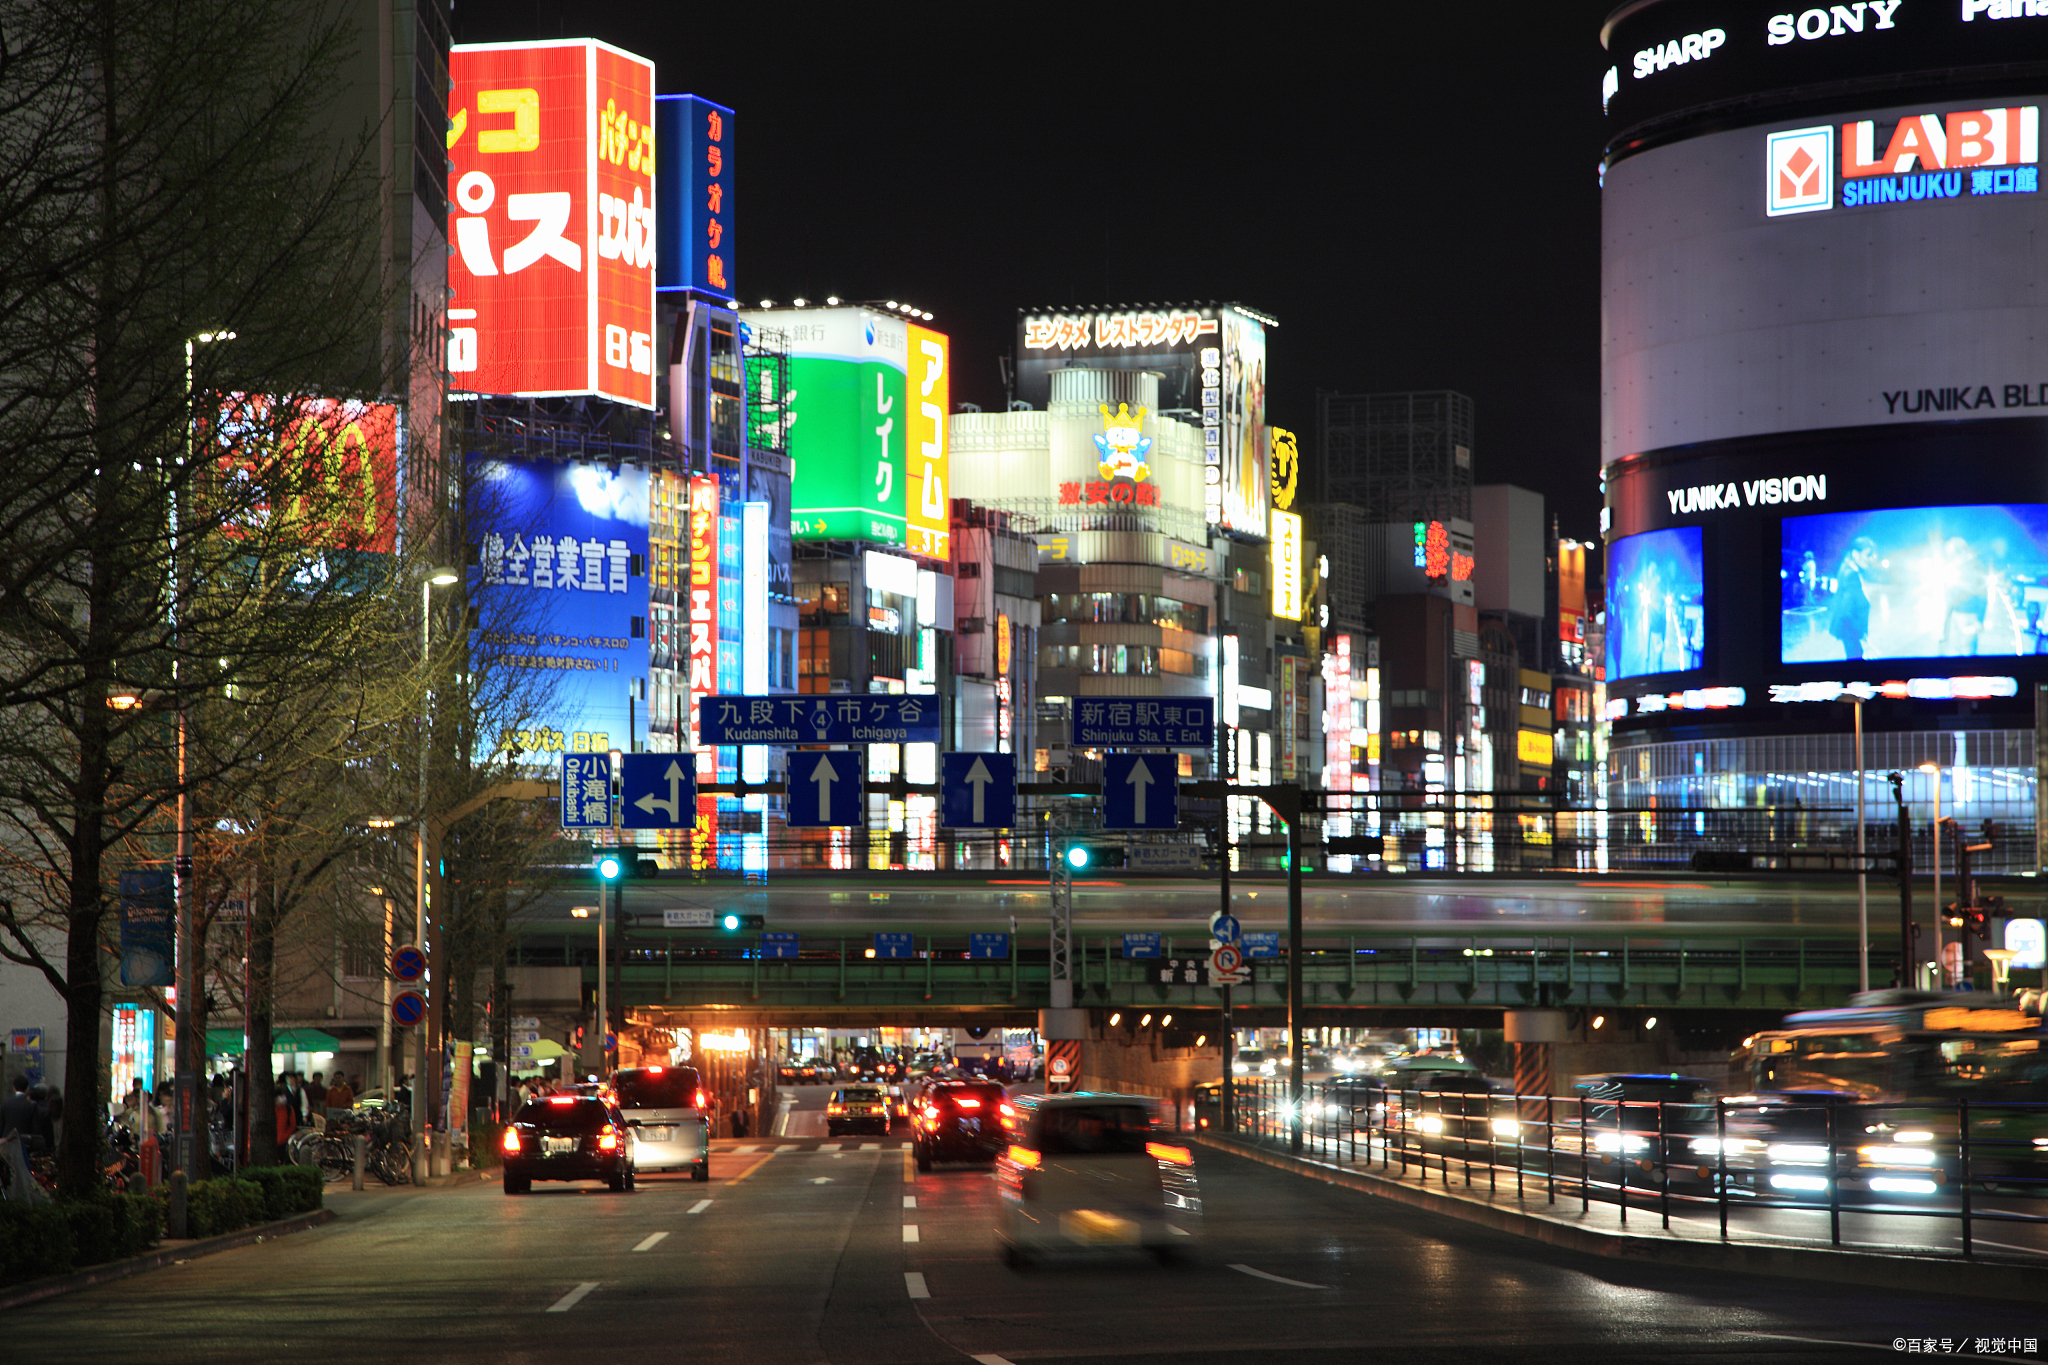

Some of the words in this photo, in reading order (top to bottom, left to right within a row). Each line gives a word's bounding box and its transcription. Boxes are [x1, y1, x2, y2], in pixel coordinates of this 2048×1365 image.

[1768, 0, 1900, 45] SONY
[1633, 28, 1726, 79] SHARP
[599, 98, 655, 176] パチンコ
[1842, 106, 2038, 178] LABI
[1843, 171, 1962, 207] SHINJUKU
[1972, 168, 2038, 196] 東口館
[599, 186, 656, 269] エスパス
[1025, 316, 1091, 350] エンタメ
[1096, 312, 1218, 347] レストランタワー
[1882, 386, 1995, 414] YUNIKA
[875, 372, 894, 502] レイク
[921, 339, 944, 520] アコム
[1668, 482, 1740, 515] YUNIKA
[1743, 474, 1826, 506] VISION
[691, 487, 711, 584] パチンコ
[922, 532, 943, 555] 3F
[480, 532, 631, 593] 健全営業宣言
[718, 699, 806, 726] 九段下
[725, 727, 799, 741] Kudanshita
[815, 713, 827, 727] 4
[852, 726, 908, 741] Ichigaya
[1080, 702, 1204, 726] 新宿駅東口
[1082, 728, 1134, 744] Shinjuku
[1138, 729, 1160, 742] Sta.
[1166, 729, 1177, 742] E.
[1181, 729, 1204, 742] Ent.
[565, 758, 581, 824] Otakibashi
[582, 757, 607, 825] 小滝橋
